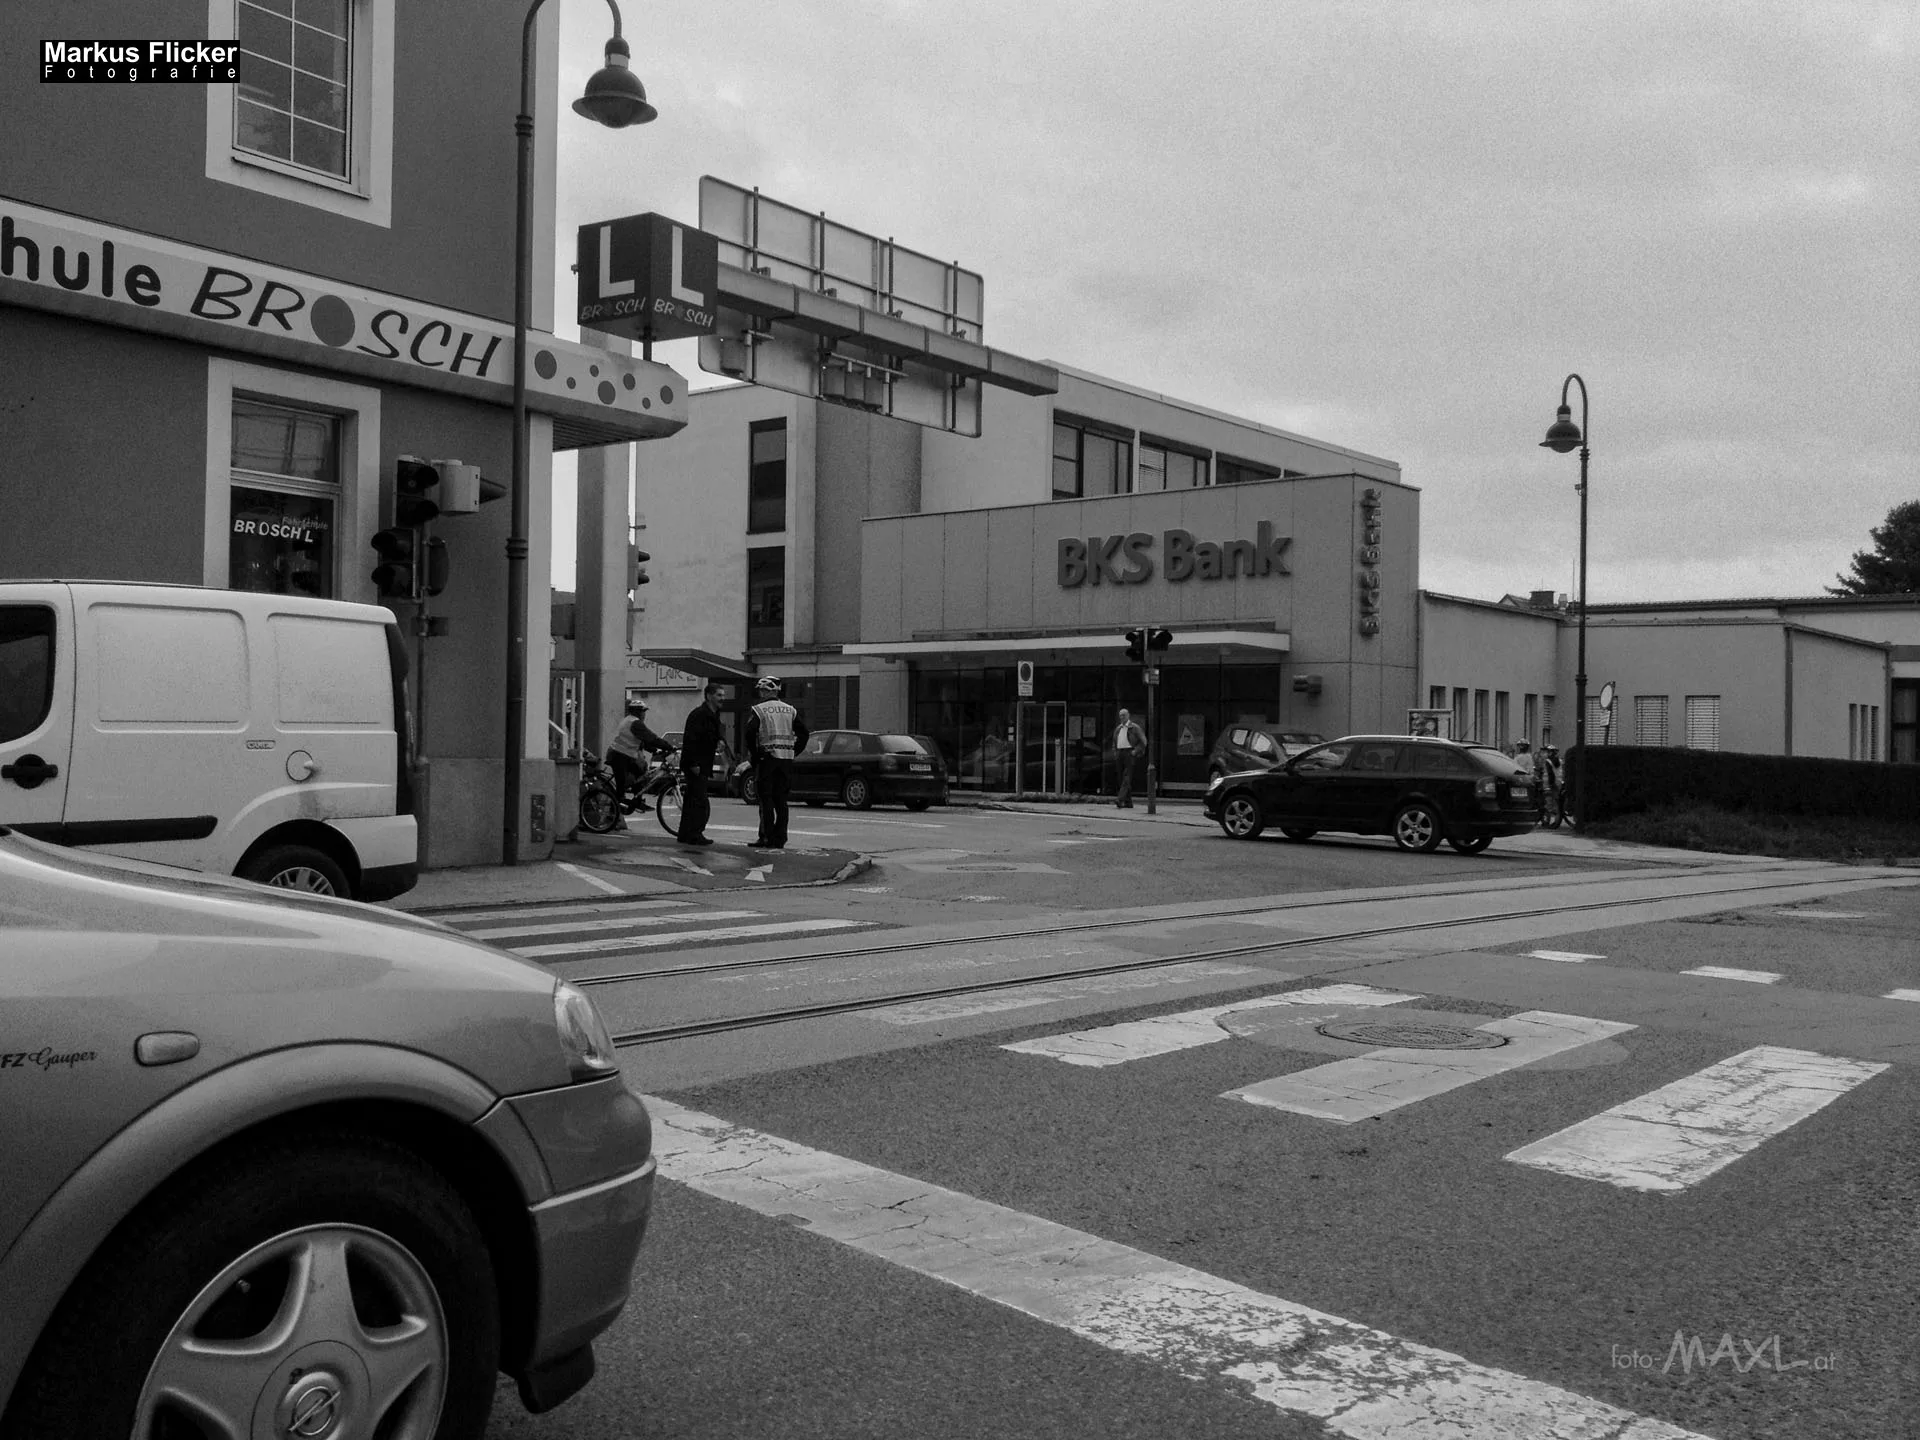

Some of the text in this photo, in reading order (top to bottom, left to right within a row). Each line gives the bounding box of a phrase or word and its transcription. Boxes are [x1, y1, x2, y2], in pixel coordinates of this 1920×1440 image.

[599, 225, 635, 298] L
[671, 225, 704, 307] L
[1057, 520, 1293, 589] BKS Bank
[0, 1046, 98, 1071] FZ Gauper
